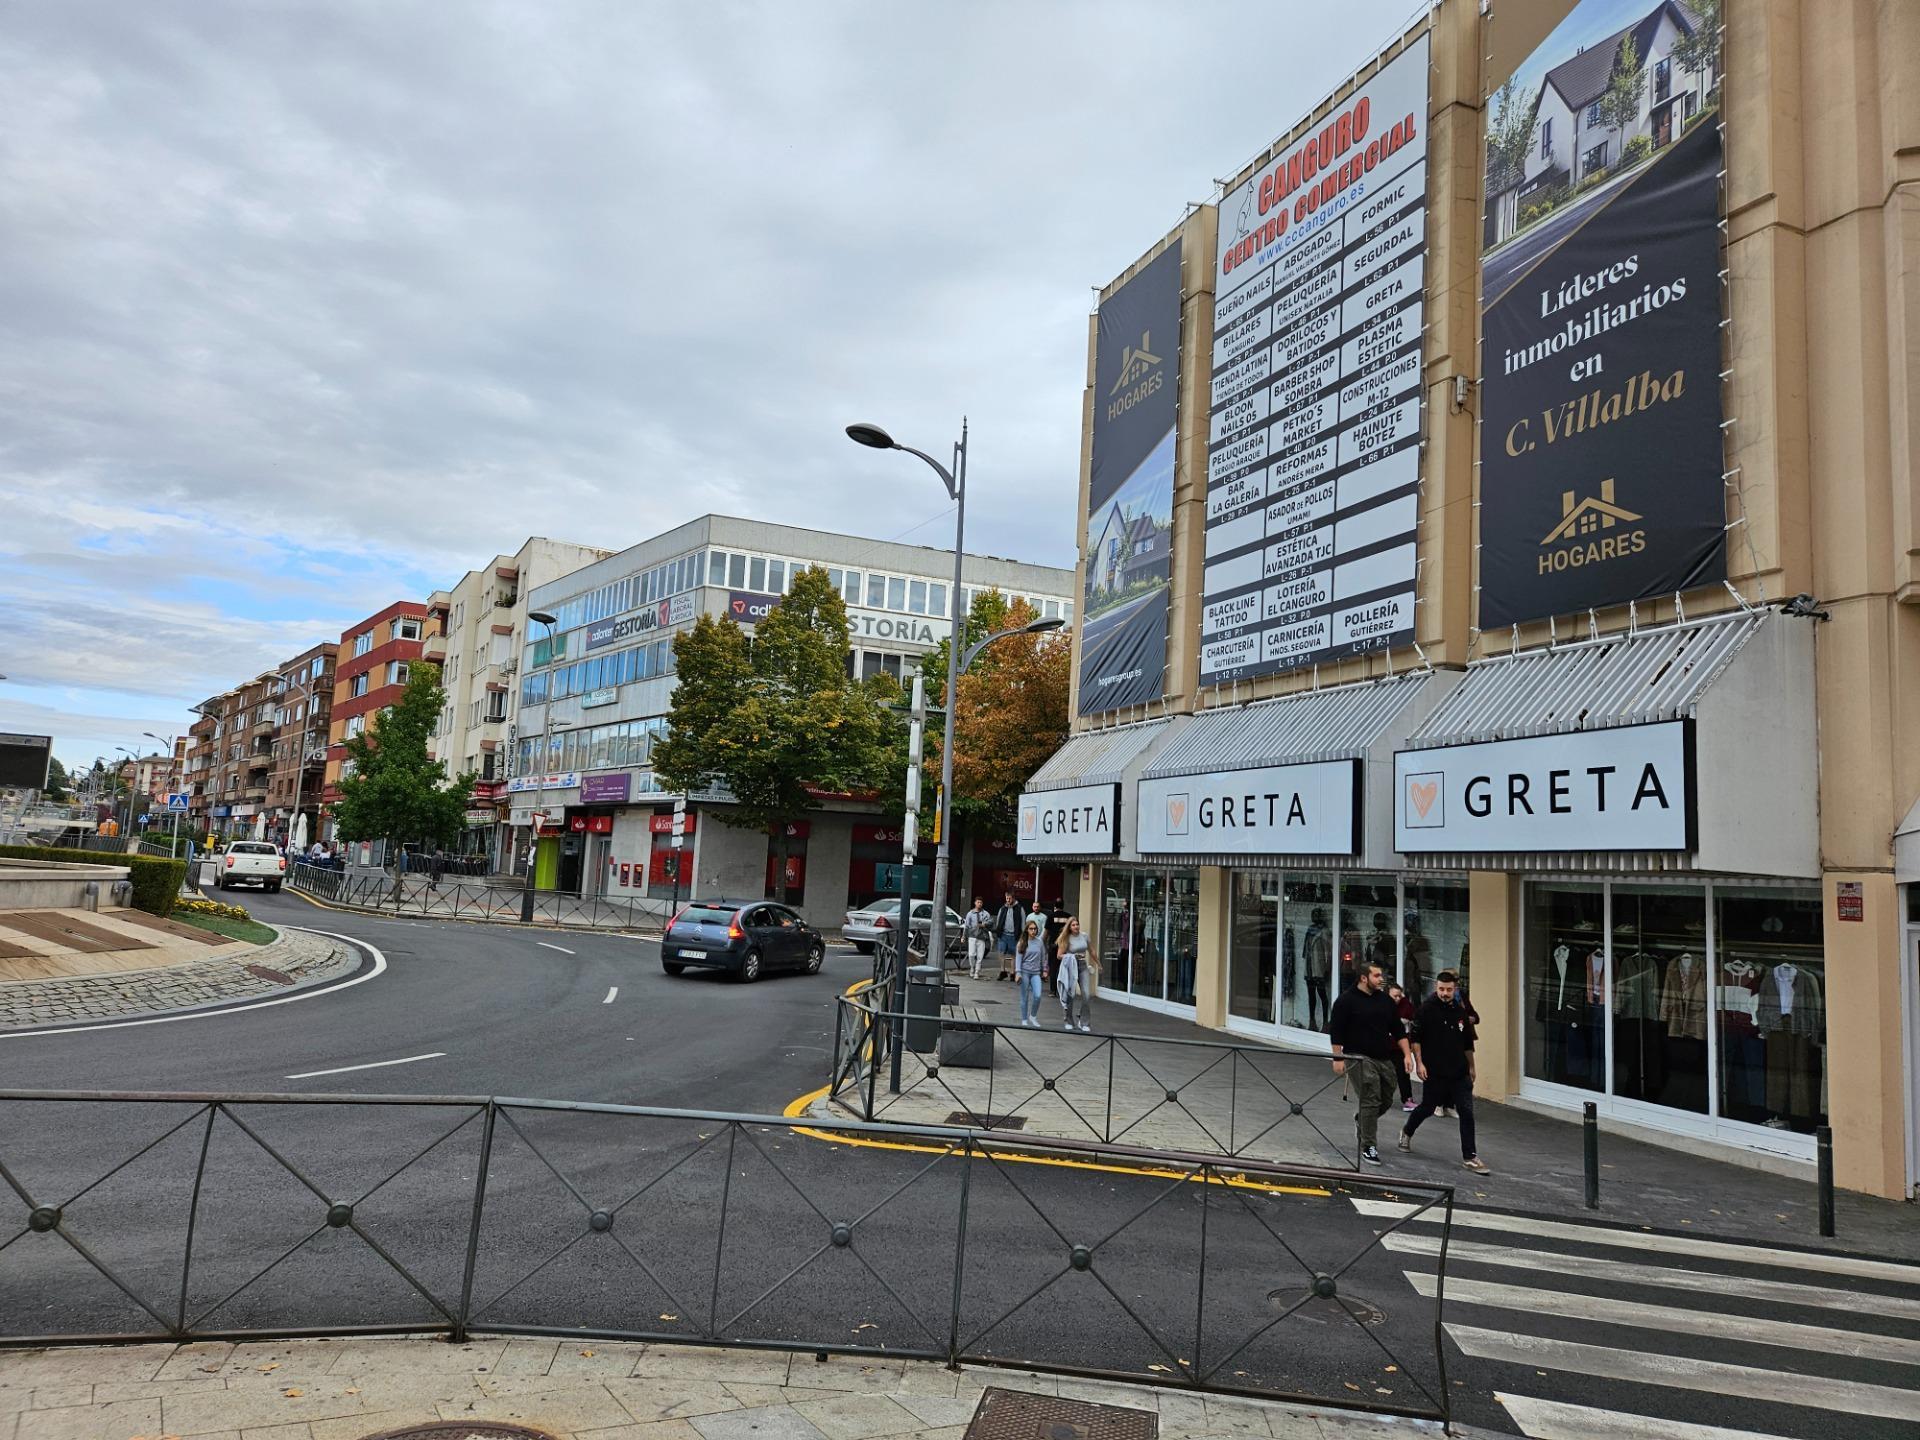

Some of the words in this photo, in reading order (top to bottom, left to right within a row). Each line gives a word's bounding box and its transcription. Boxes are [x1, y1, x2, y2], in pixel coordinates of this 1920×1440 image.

[1258, 96, 1370, 216] CANGURO
[1223, 208, 1289, 276] CENTRO
[1294, 112, 1417, 224] COMERCIAL
[1362, 185, 1404, 223] FORMIC
[1258, 184, 1365, 265] www.cccanguro.es
[1284, 231, 1331, 270] ABOGADO
[1321, 239, 1340, 255] GÓMEZ
[1354, 226, 1412, 271] SEGURDAL
[1218, 294, 1244, 319] SUEÑO
[1246, 276, 1270, 300] NAILS
[1277, 269, 1336, 314] PELUQUERÍA
[1366, 280, 1402, 308] GRETA
[1541, 254, 1638, 318] Líderes
[1279, 306, 1302, 324] UNISEX
[1304, 287, 1332, 309] NATALIA
[1223, 317, 1260, 348] BILLARES
[1278, 314, 1328, 352] DORILOCOS
[1330, 309, 1336, 320] Y
[1358, 317, 1402, 350] PLASMA
[1504, 276, 1687, 376] inmobiliarios
[1227, 335, 1254, 356] CANGURO
[1287, 330, 1325, 360] BATIDOS
[1358, 332, 1401, 364] ESTETIC
[1214, 370, 1239, 390] TIENDA
[1241, 353, 1267, 375] LATINA
[1274, 370, 1307, 396] BARBER
[1310, 356, 1334, 377] SHOP
[1343, 356, 1416, 402] CONSTRUCCIONES
[1570, 352, 1604, 382] en
[1108, 371, 1162, 422] HOGARES
[1285, 377, 1321, 404] SOMBRA
[1367, 386, 1388, 406] M-12
[1225, 399, 1252, 421] BLOON
[1353, 409, 1401, 441] HAINUTE
[1505, 418, 1536, 457] C.
[1542, 368, 1686, 445] Villalba
[1220, 416, 1243, 435] NAILS
[1283, 418, 1321, 445] MARKET
[1359, 426, 1394, 451] BOTEZ
[1212, 434, 1263, 466] PELUQUERÍA
[1215, 462, 1234, 475] SERGIO
[1236, 450, 1259, 465] ARAQUE
[1276, 444, 1326, 475] REFORMAS
[1228, 481, 1244, 495] BAR
[1278, 471, 1303, 486] ANDRÉS
[1305, 462, 1323, 476] MERA
[1213, 502, 1222, 513] LA
[1224, 486, 1258, 509] GALERÍA
[1268, 501, 1295, 520] ASADOR
[1305, 486, 1332, 506] POLLOS
[1288, 510, 1310, 524] UMAMI
[1266, 550, 1312, 574] AVANZADA
[1315, 543, 1330, 557] TJC
[1277, 535, 1317, 557] ESTÉTICA
[1538, 530, 1646, 575] HOGARES
[1268, 604, 1277, 615] EL
[1280, 590, 1325, 612] CANGURO
[1277, 577, 1315, 599] LOTERÍA
[1209, 602, 1234, 617] BLACK
[1236, 596, 1254, 610] LINE
[1215, 611, 1247, 627] TATTOO
[1345, 600, 1398, 626] POLLERÍA
[848, 613, 934, 642] STORÍA
[1268, 620, 1324, 645] CARNICERÍA
[1350, 620, 1393, 637] GUTIÉRREZ
[1207, 636, 1253, 658] CHARCUTERÍA
[1214, 655, 1245, 667] GUTIÉRREZ
[1270, 645, 1289, 655] HNOS.
[1291, 638, 1320, 651] SEGOVIA
[1464, 762, 1669, 818] GRETA
[1042, 806, 1108, 834] GRETA
[1199, 792, 1306, 828] GRETA
